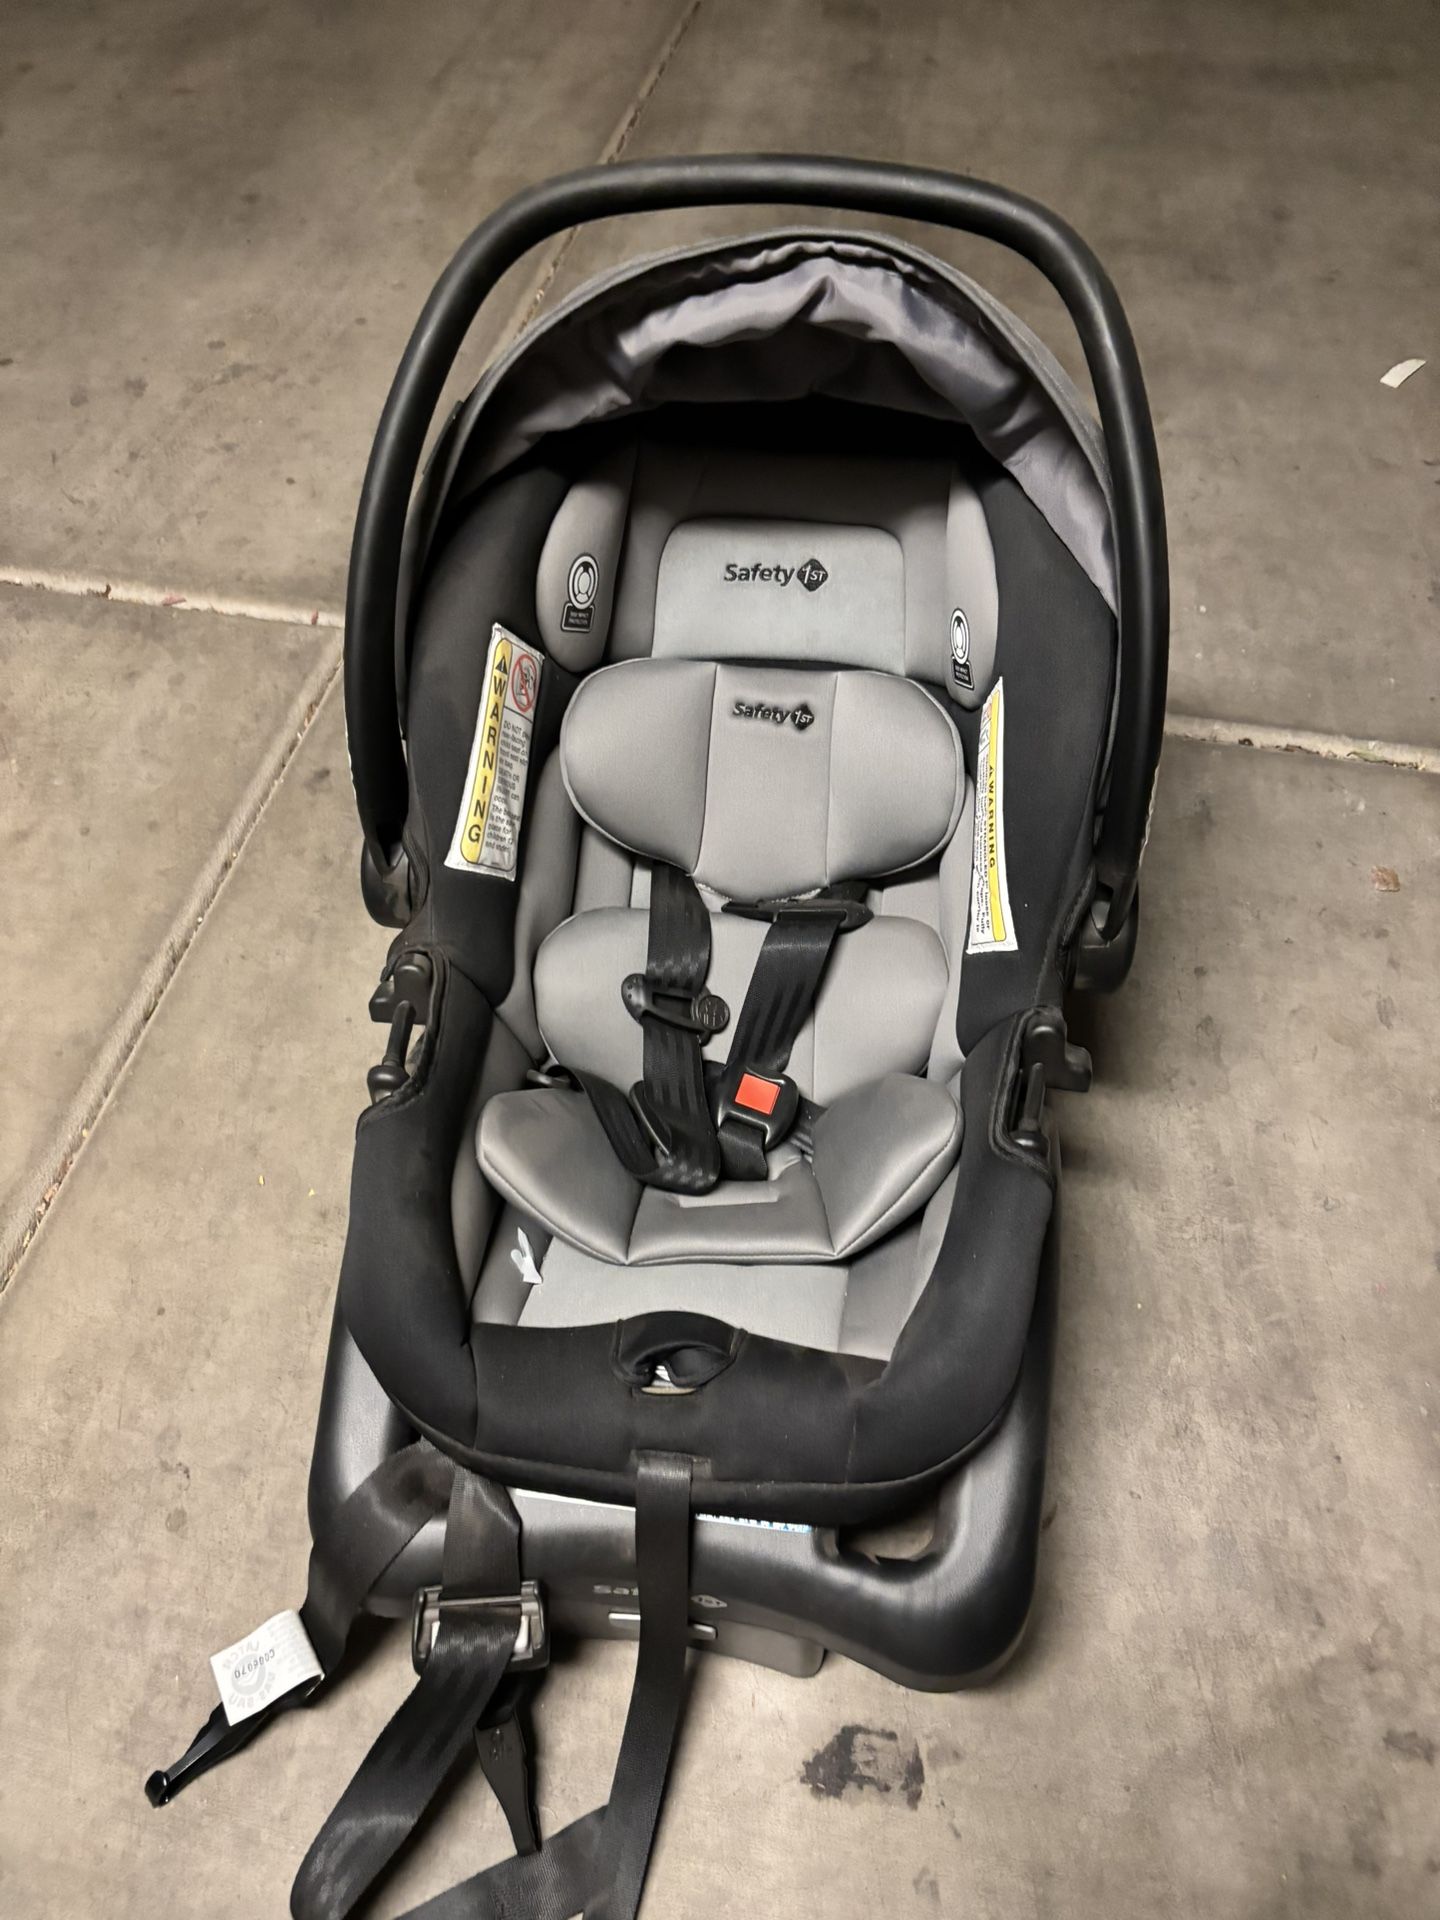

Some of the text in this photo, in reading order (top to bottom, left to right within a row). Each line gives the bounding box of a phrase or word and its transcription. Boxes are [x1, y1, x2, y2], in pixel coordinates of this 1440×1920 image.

[724, 563, 795, 587] Safety
[733, 701, 792, 724] Safety
[468, 675, 506, 844] WARNING
